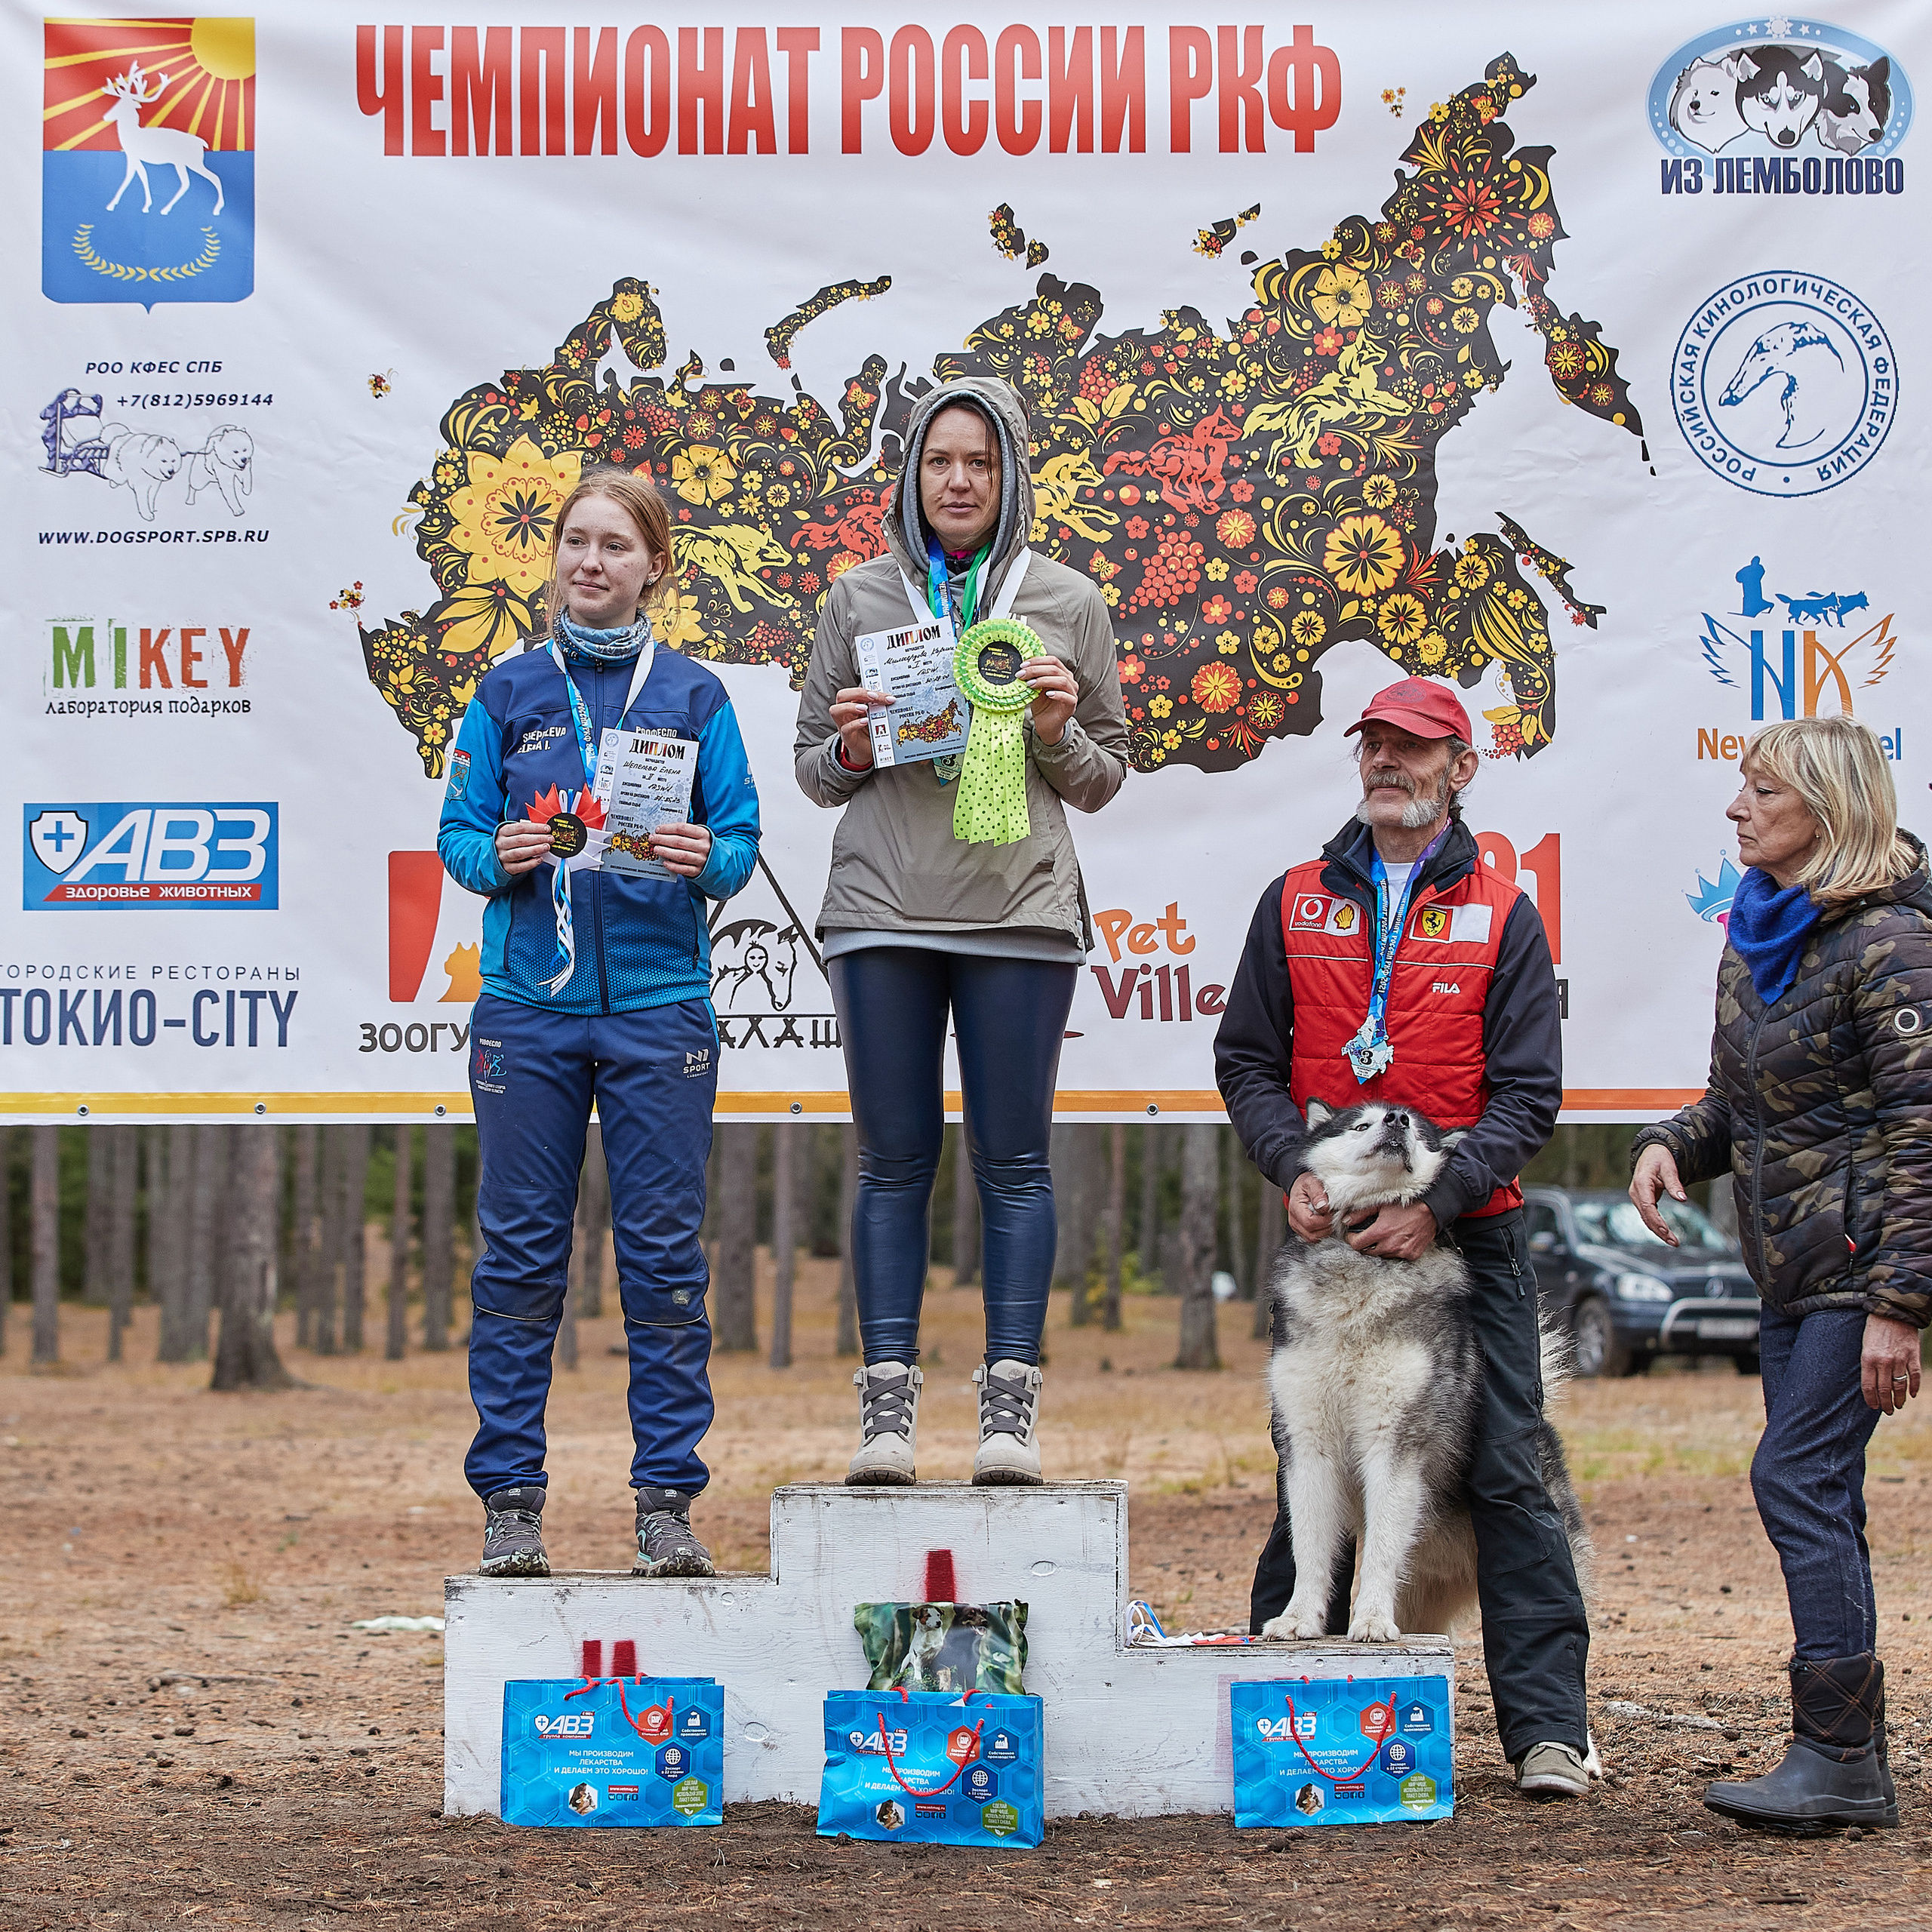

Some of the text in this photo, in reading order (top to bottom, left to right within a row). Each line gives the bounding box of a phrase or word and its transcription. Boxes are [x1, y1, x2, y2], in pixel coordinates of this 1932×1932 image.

[355, 23, 1342, 158] ЧЕМПИОНАТ РОССИИ РКФ
[1660, 156, 1905, 195] ИЗ ЛЕМБОЛОВО
[85, 361, 223, 374] РОО КФЕС СПБ
[1679, 278, 1890, 481] РОССИЙСКАЯ КИНОЛОГИЧЕСКАЯ ФЕДЕРАЦИЯ
[117, 393, 274, 409] +7(812)5969144
[38, 529, 269, 544] WWW.DOGSPORT.SPB.RU
[887, 624, 941, 651] ДИПЛОМ
[51, 626, 251, 690] MIKEY
[45, 697, 251, 718] лаборатория подарков
[629, 738, 686, 760] ДИПЛОМ
[65, 886, 252, 901] здоровье животных
[1091, 900, 1196, 964] Pet
[0, 964, 300, 983] ОРОДСКИЕ РЕСТОРАНЫ
[1090, 962, 1227, 1022] Ville
[1377, 977, 1388, 993] 2021
[1432, 982, 1460, 994] FILA
[0, 988, 299, 1048] ТОКИО-CITY
[358, 1023, 470, 1053] ЗООГУ
[717, 1017, 843, 1049] АЛАШ
[683, 1062, 710, 1074] SPORT
[1359, 1050, 1374, 1066] 3
[561, 1767, 592, 1775] ДЕЛАЕМ
[871, 1782, 900, 1792] ДЕЛАЕМ
